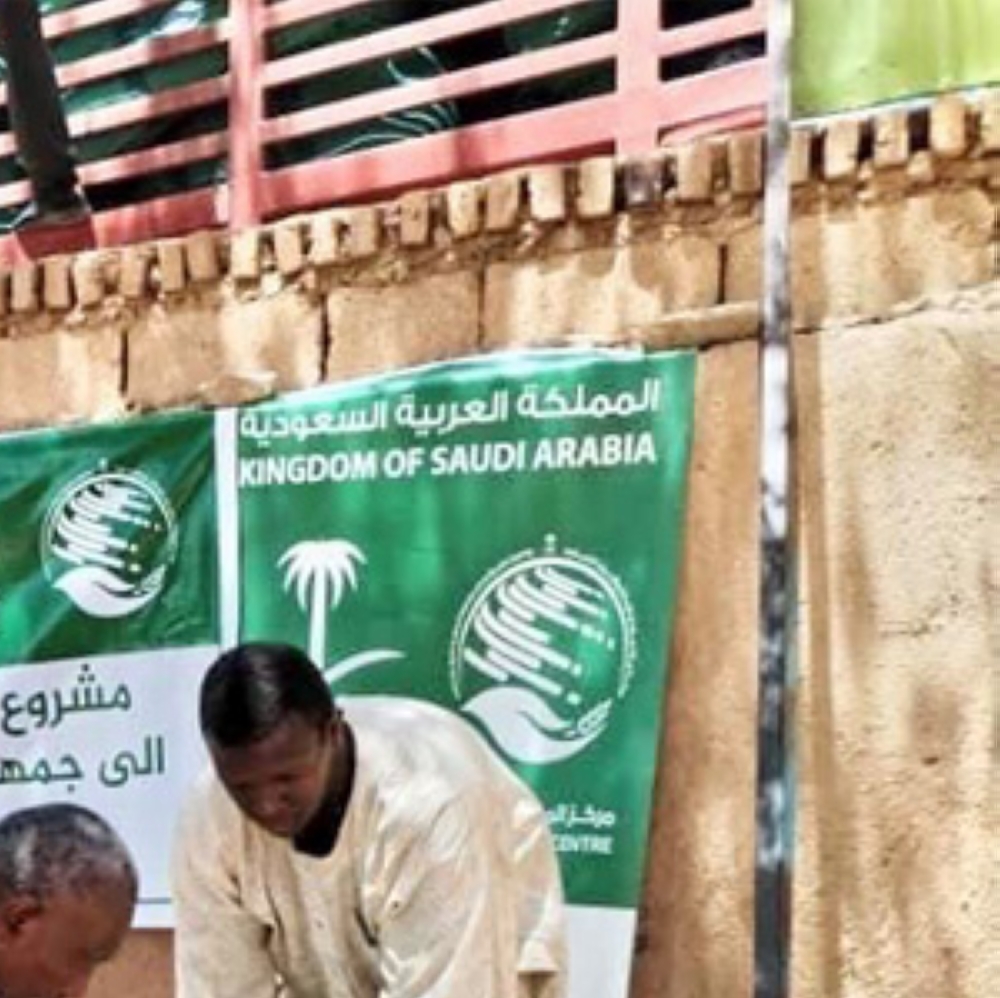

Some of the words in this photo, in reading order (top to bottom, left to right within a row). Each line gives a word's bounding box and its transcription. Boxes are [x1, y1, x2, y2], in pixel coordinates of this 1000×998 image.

[394, 389, 508, 437] العربية
[517, 377, 661, 418] المملكة
[240, 400, 388, 447] السعودية
[239, 450, 378, 486] KINGDOM
[383, 447, 424, 479] OF
[430, 439, 526, 476] SAUDI
[532, 430, 657, 469] ARABIA
[0, 663, 132, 736] مشروع
[99, 734, 165, 787] الى
